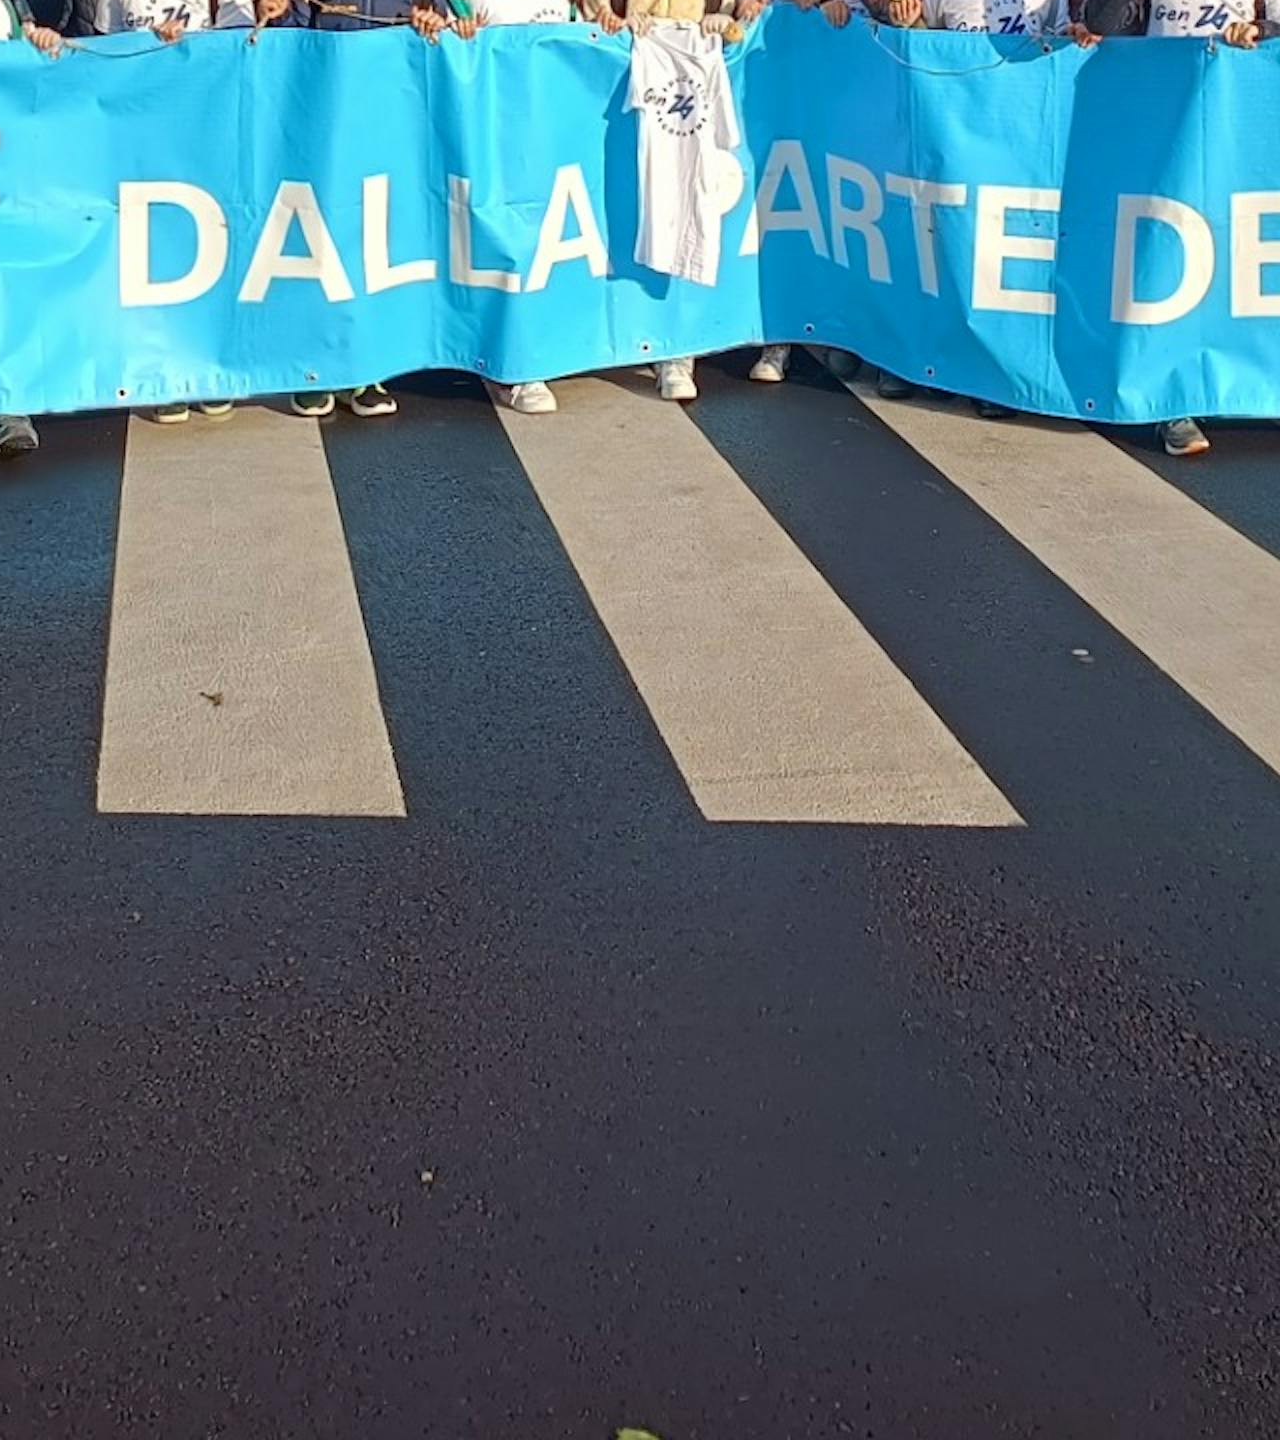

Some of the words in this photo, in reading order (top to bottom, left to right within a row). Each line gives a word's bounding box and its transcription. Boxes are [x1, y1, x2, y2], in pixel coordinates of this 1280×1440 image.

[126, 11, 156, 28] Gen
[1155, 4, 1190, 22] Gen
[118, 162, 614, 308] DALLA
